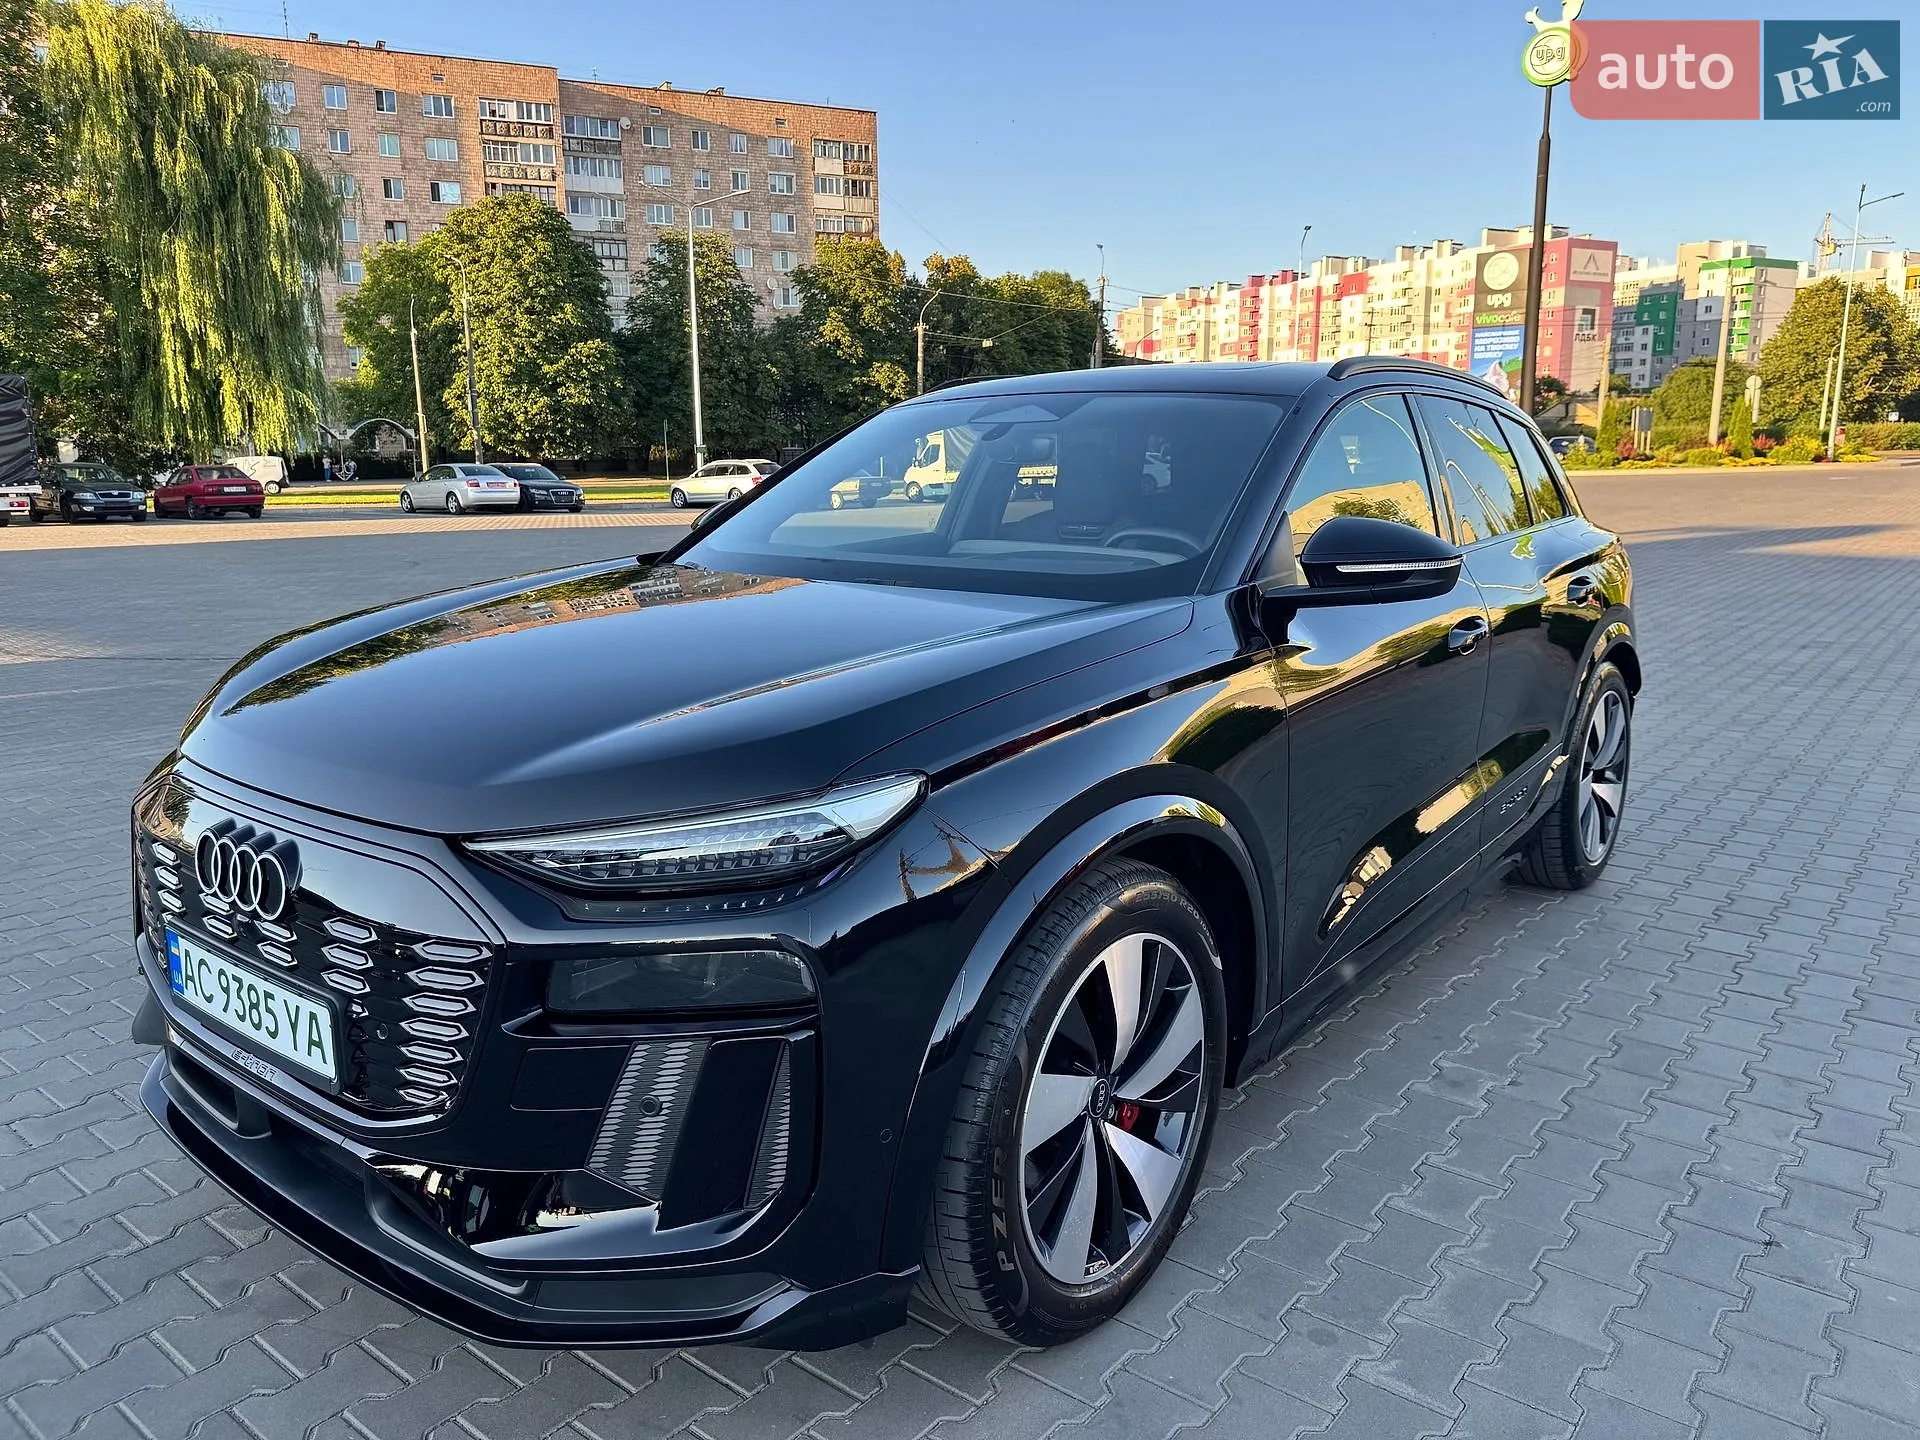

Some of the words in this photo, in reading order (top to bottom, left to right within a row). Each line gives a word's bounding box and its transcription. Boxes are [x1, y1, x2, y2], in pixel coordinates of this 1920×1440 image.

[1535, 46, 1566, 62] upg
[1486, 293, 1512, 308] upg
[174, 971, 184, 986] UA
